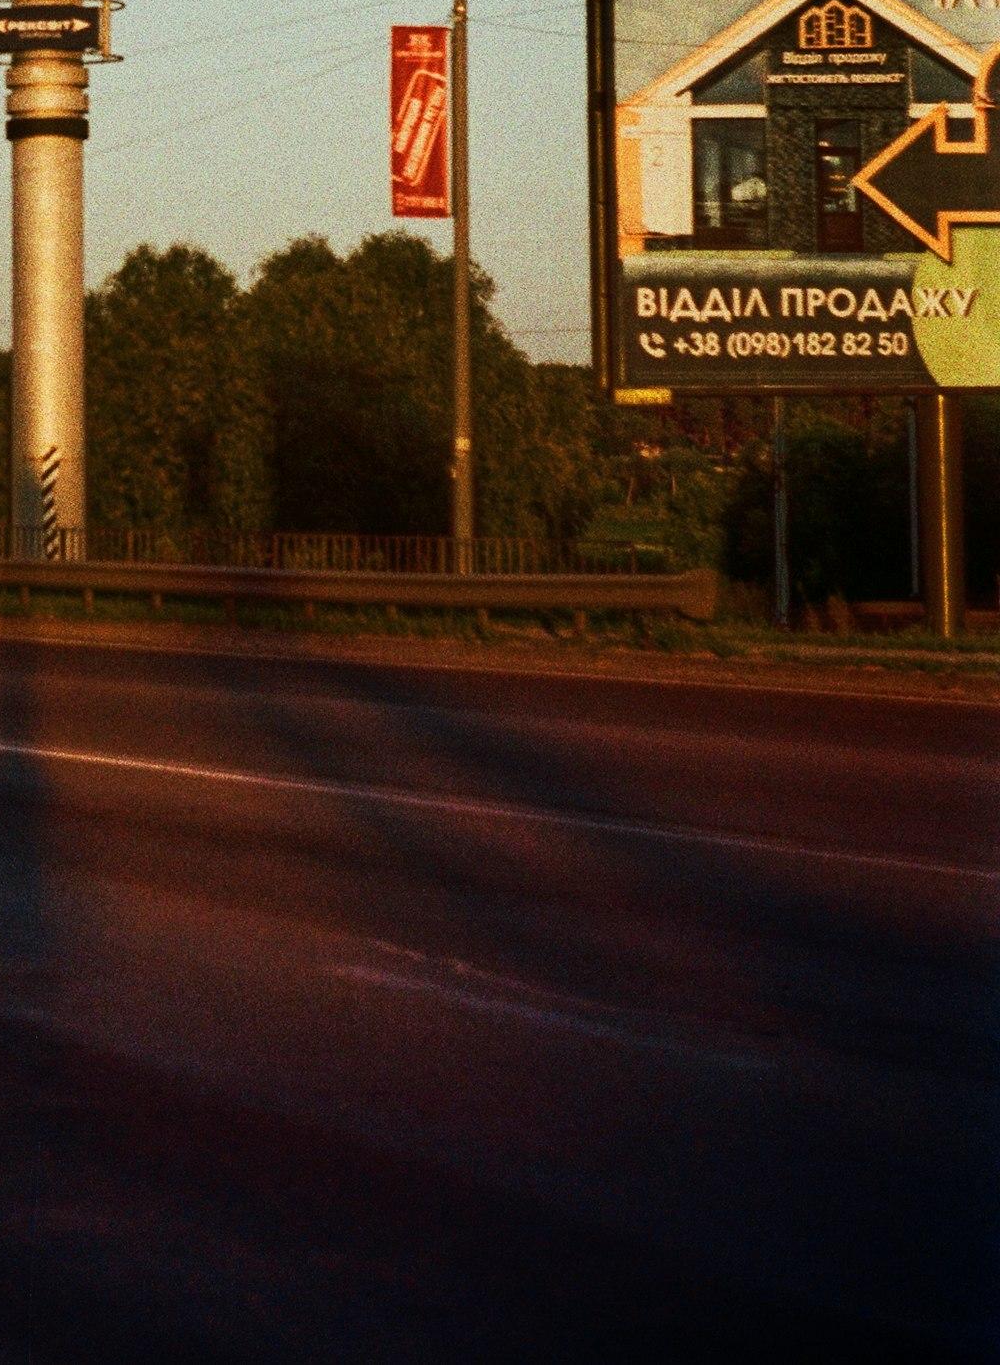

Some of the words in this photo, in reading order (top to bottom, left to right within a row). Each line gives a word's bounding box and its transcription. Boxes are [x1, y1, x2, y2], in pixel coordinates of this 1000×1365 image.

[636, 287, 771, 323] ВІДДІЛ
[780, 287, 979, 323] ПРОДАЖУ
[673, 332, 721, 357] +38
[842, 332, 872, 356] 82
[878, 332, 909, 356] 50
